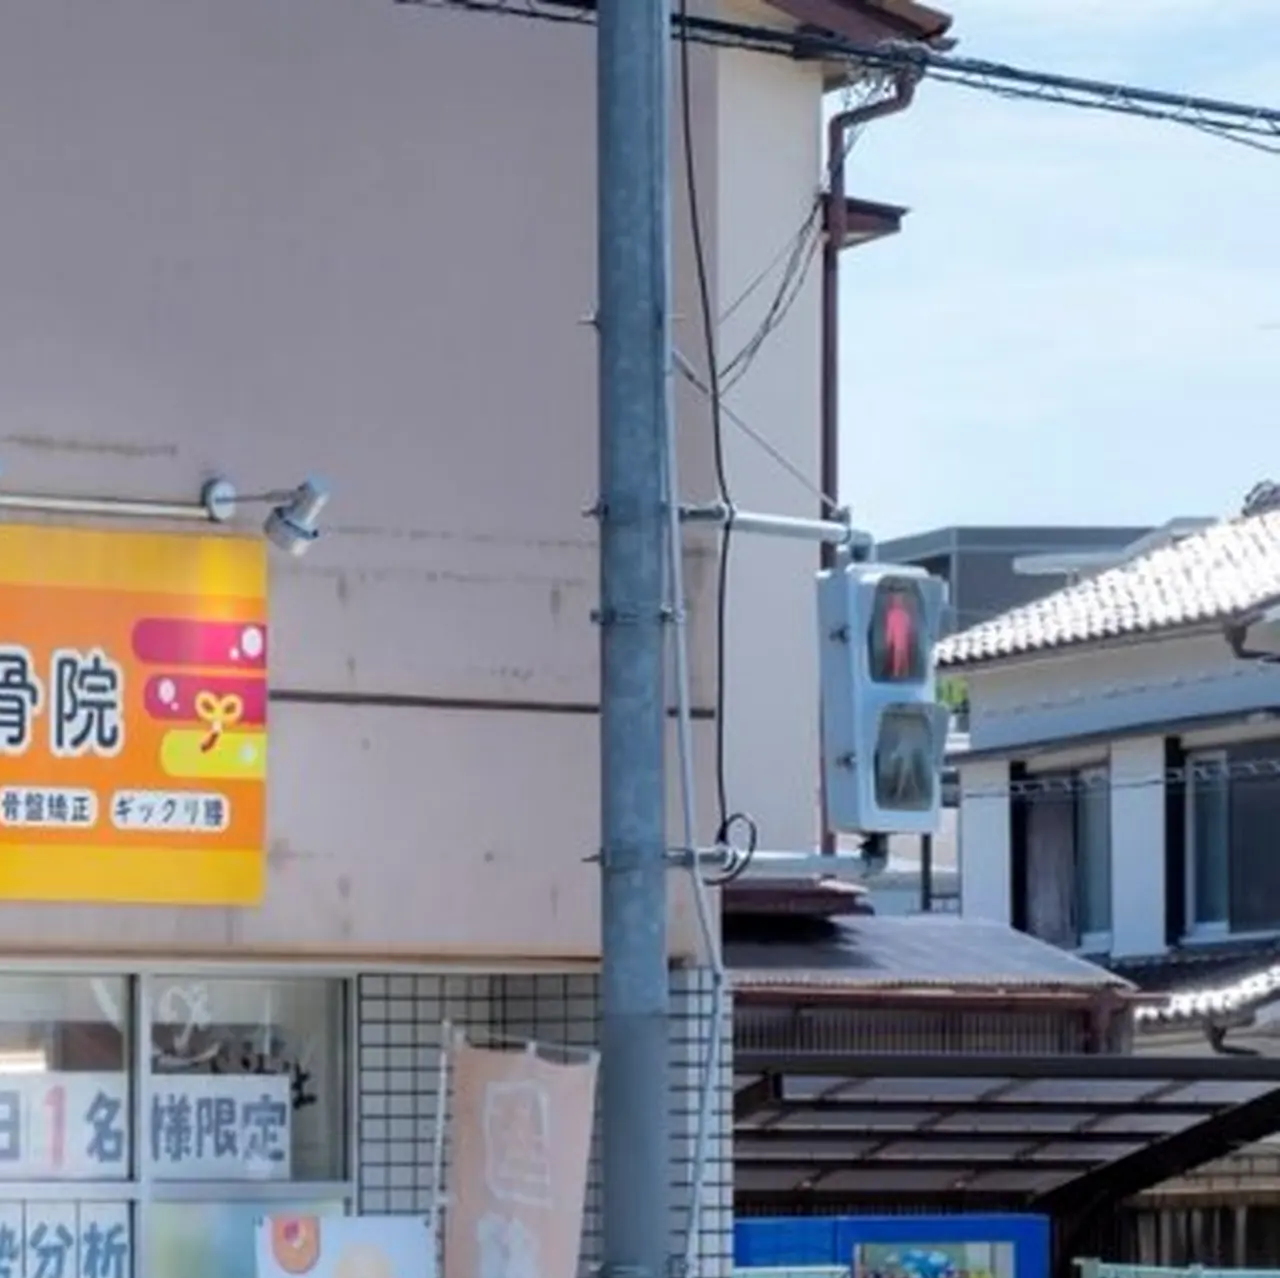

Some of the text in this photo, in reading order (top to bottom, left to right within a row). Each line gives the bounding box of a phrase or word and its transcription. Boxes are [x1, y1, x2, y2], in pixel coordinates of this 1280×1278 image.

[2, 791, 90, 823] 骨盤矯正
[115, 796, 223, 827] ギックリ腰
